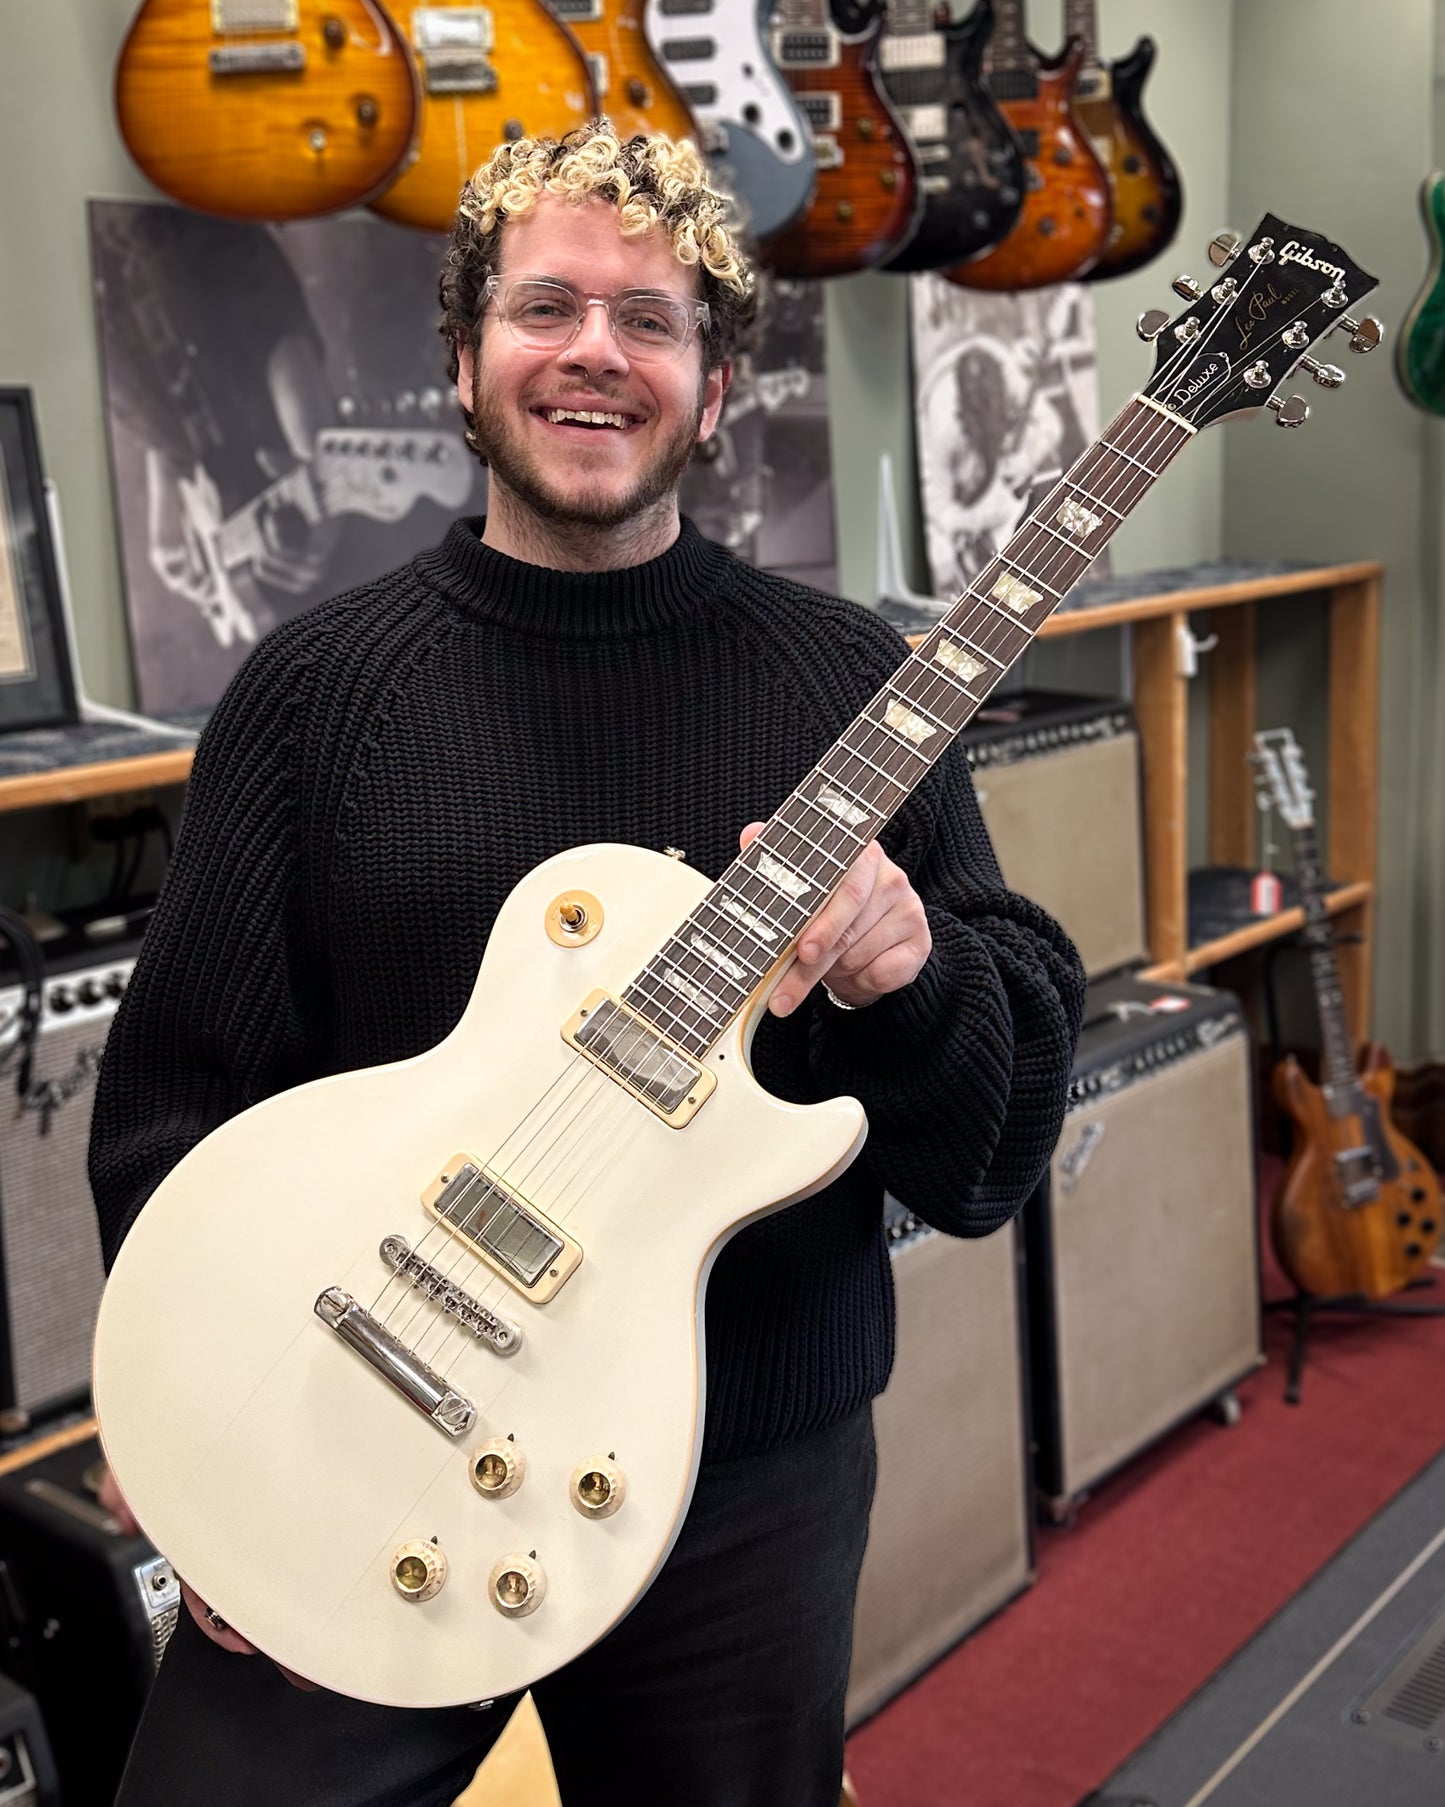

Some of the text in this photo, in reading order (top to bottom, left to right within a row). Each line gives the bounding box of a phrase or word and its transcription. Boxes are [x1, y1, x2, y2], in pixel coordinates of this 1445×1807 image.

[1278, 240, 1346, 282] Gibson
[1235, 282, 1283, 351] Les Paul
[1173, 363, 1219, 406] Deluxe
